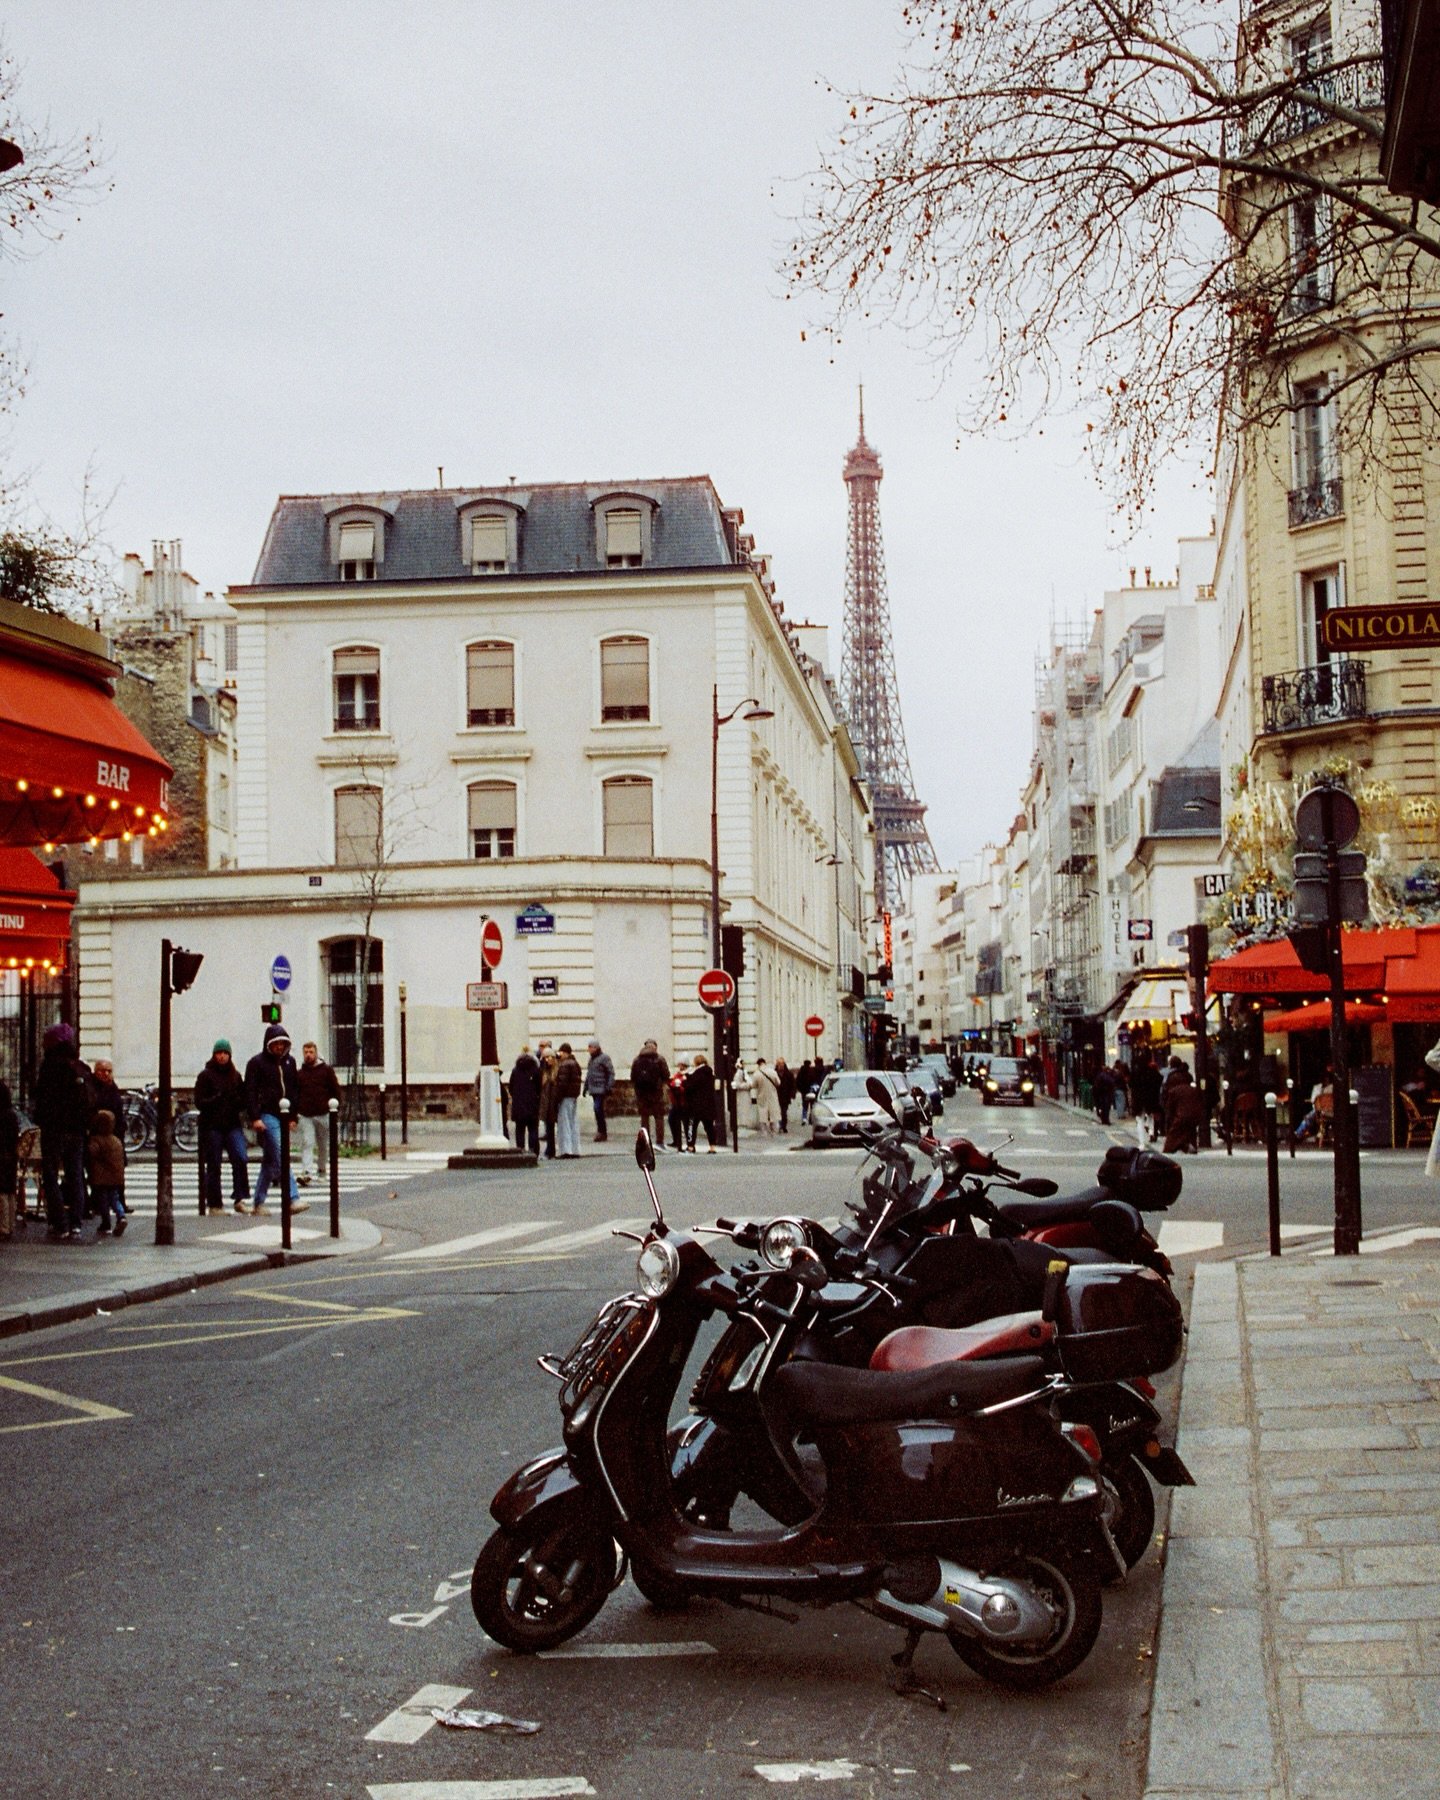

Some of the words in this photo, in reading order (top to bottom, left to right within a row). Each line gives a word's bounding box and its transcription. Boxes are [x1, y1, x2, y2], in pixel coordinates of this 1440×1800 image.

[1335, 612, 1440, 639] NICOLA
[97, 760, 130, 792] BAR
[1111, 899, 1121, 955] HOTEL
